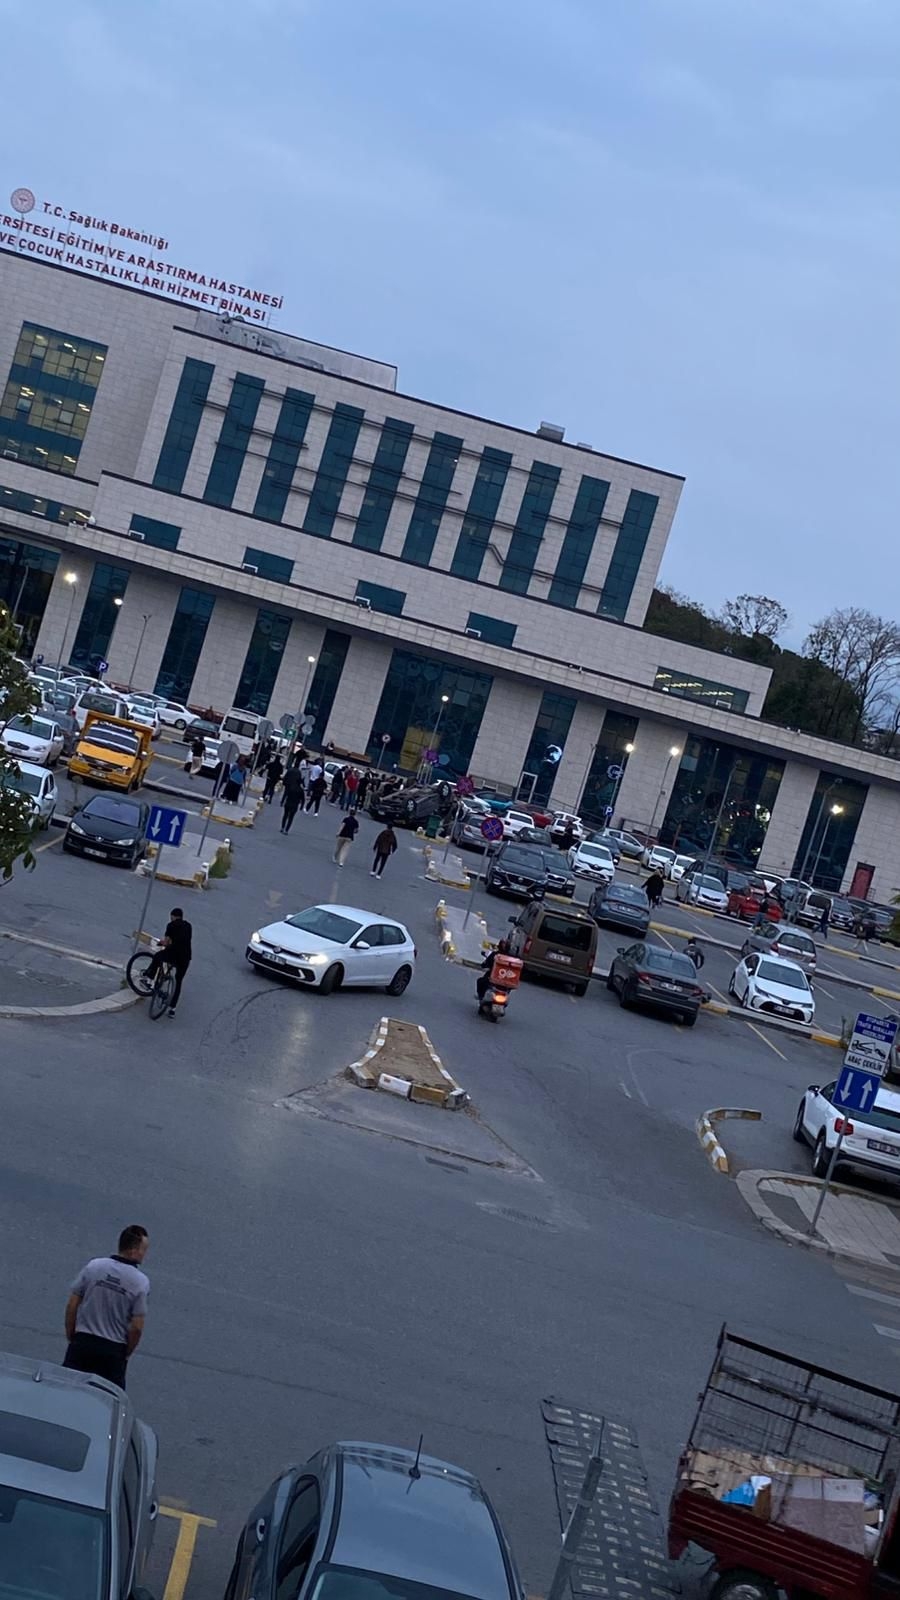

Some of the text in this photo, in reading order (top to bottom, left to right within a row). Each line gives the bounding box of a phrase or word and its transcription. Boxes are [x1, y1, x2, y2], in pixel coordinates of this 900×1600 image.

[43, 202, 168, 249] T.C. Sağlık Bakanlığı
[0, 231, 266, 320] VE ÇOCUK HASTALIKLARI HİZMET BİNASI
[57, 232, 105, 256] EĞİTİM
[107, 247, 126, 260] VE
[127, 254, 206, 286] ARAŞTIRMA
[209, 278, 284, 309] HASTANESİ
[847, 1055, 862, 1066] ARAÇ
